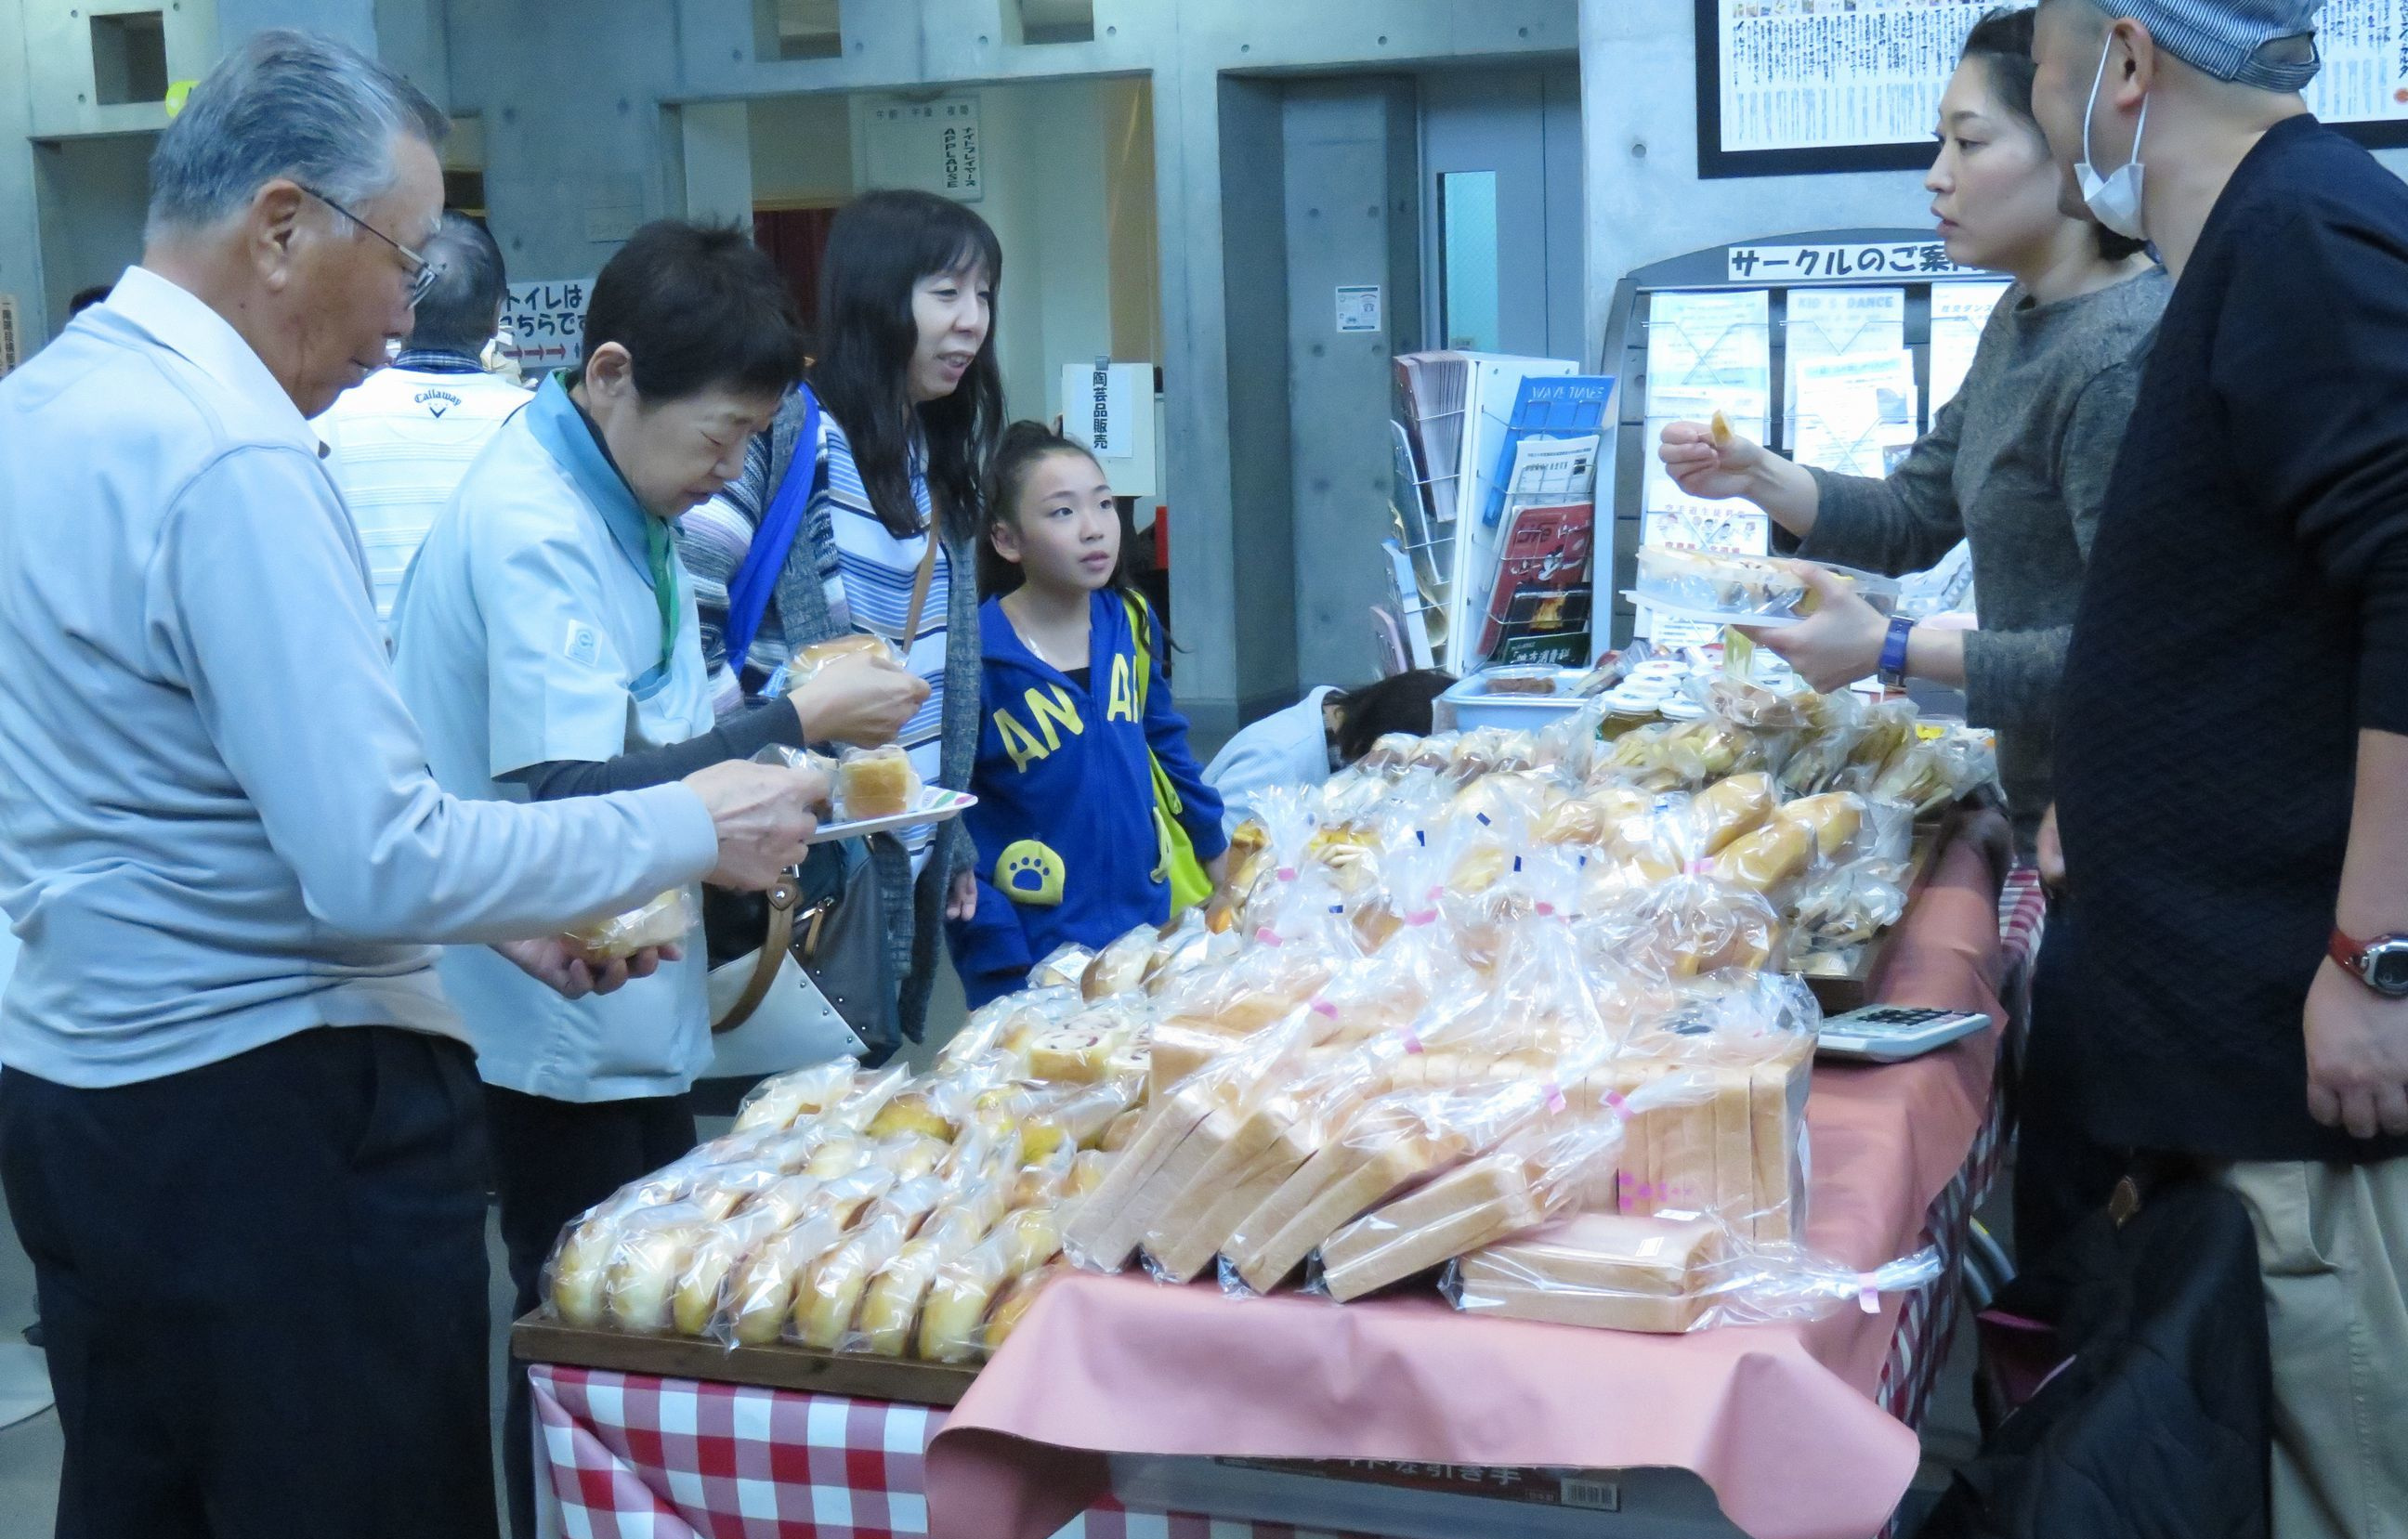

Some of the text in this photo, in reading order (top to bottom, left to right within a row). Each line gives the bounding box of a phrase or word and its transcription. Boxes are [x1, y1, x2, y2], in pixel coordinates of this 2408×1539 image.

[944, 127, 958, 189] APPLAUSE
[1731, 243, 1979, 278] サークルのご案
[506, 283, 583, 312] トイレは
[414, 388, 462, 406] Callaway
[1093, 371, 1108, 450] 陶芸品販売
